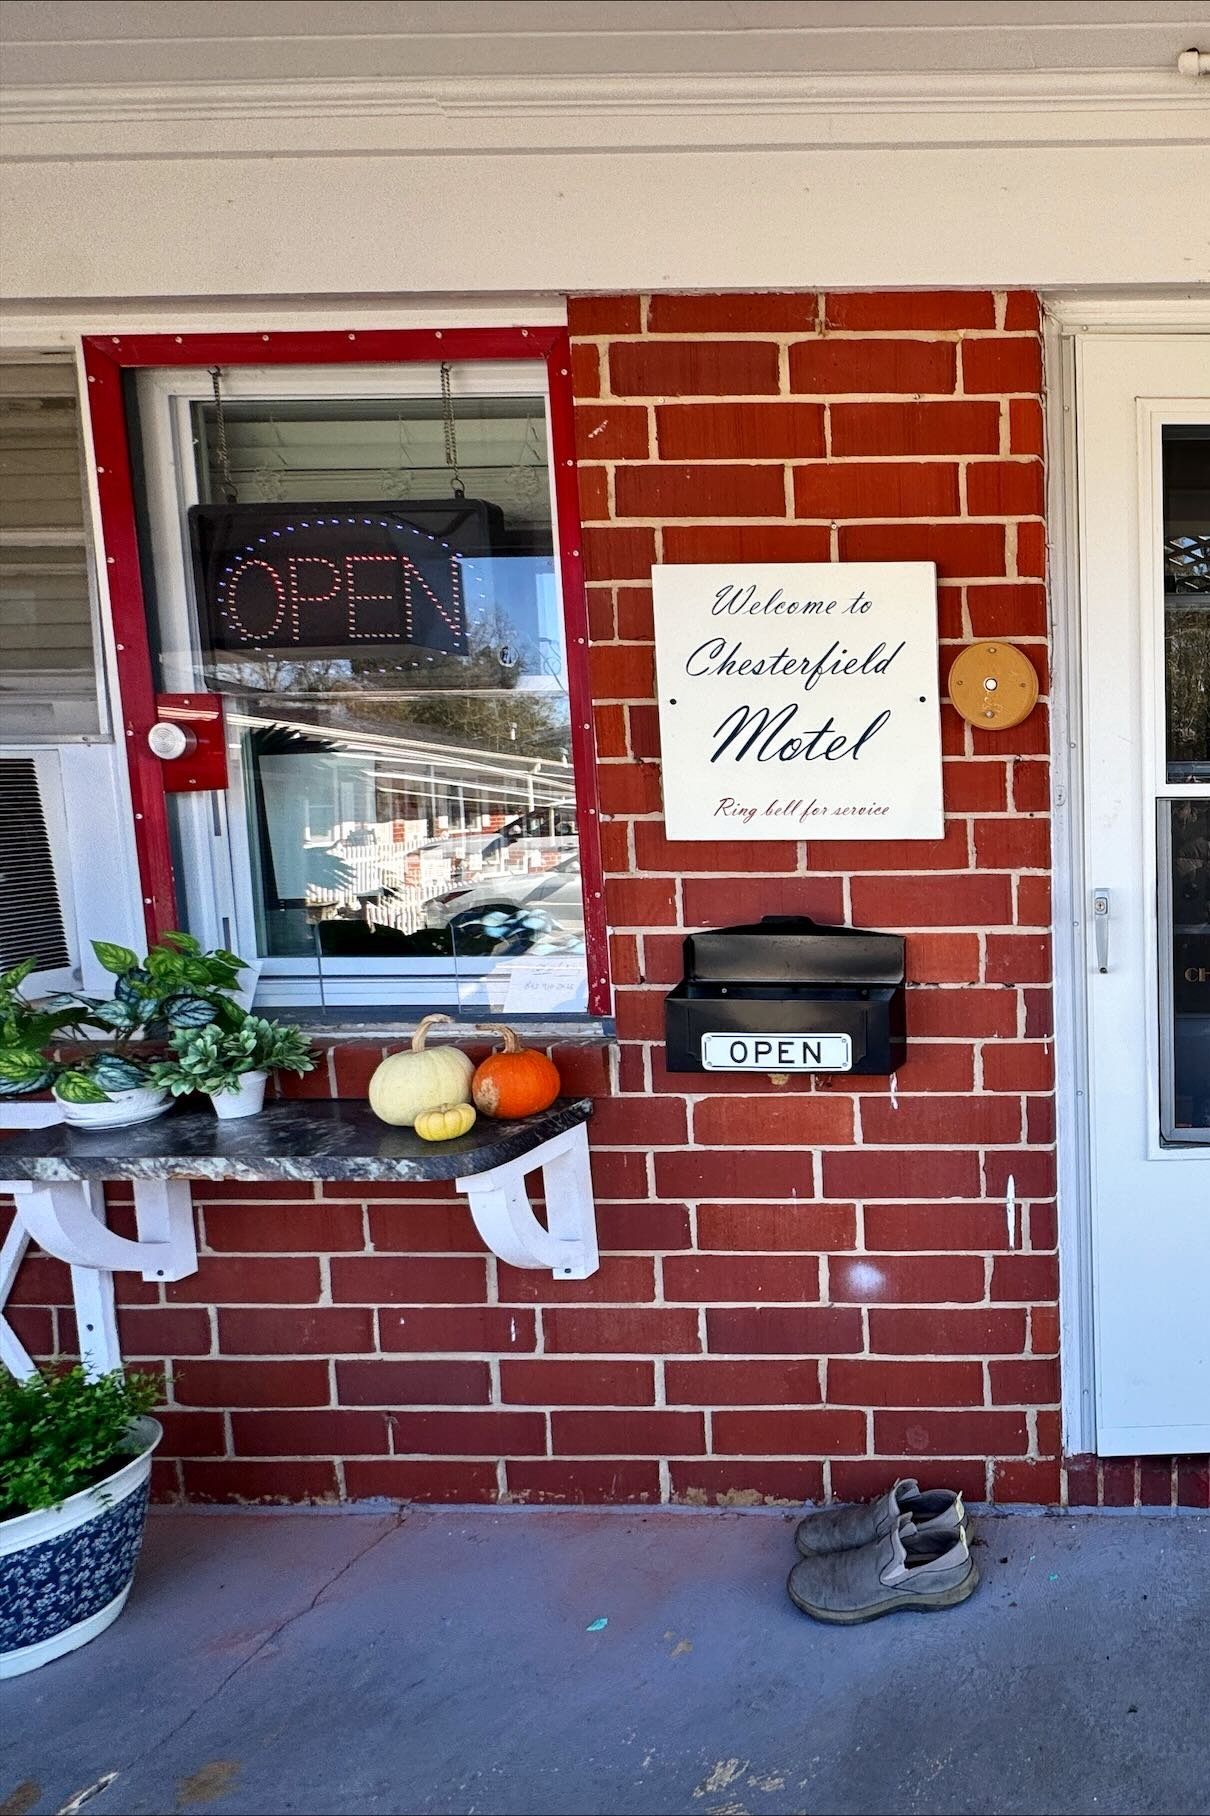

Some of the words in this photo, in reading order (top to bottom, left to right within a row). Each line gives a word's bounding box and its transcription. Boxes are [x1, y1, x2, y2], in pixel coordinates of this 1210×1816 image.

[228, 554, 462, 647] OPEN
[711, 584, 837, 616] Welcome
[843, 591, 873, 616] to
[685, 637, 906, 691] Chesterfield
[710, 703, 891, 764] Motel
[713, 797, 757, 822] Ring
[763, 799, 800, 816] bell
[795, 798, 828, 823] for
[833, 802, 890, 817] service
[730, 1040, 822, 1064] OPEN
